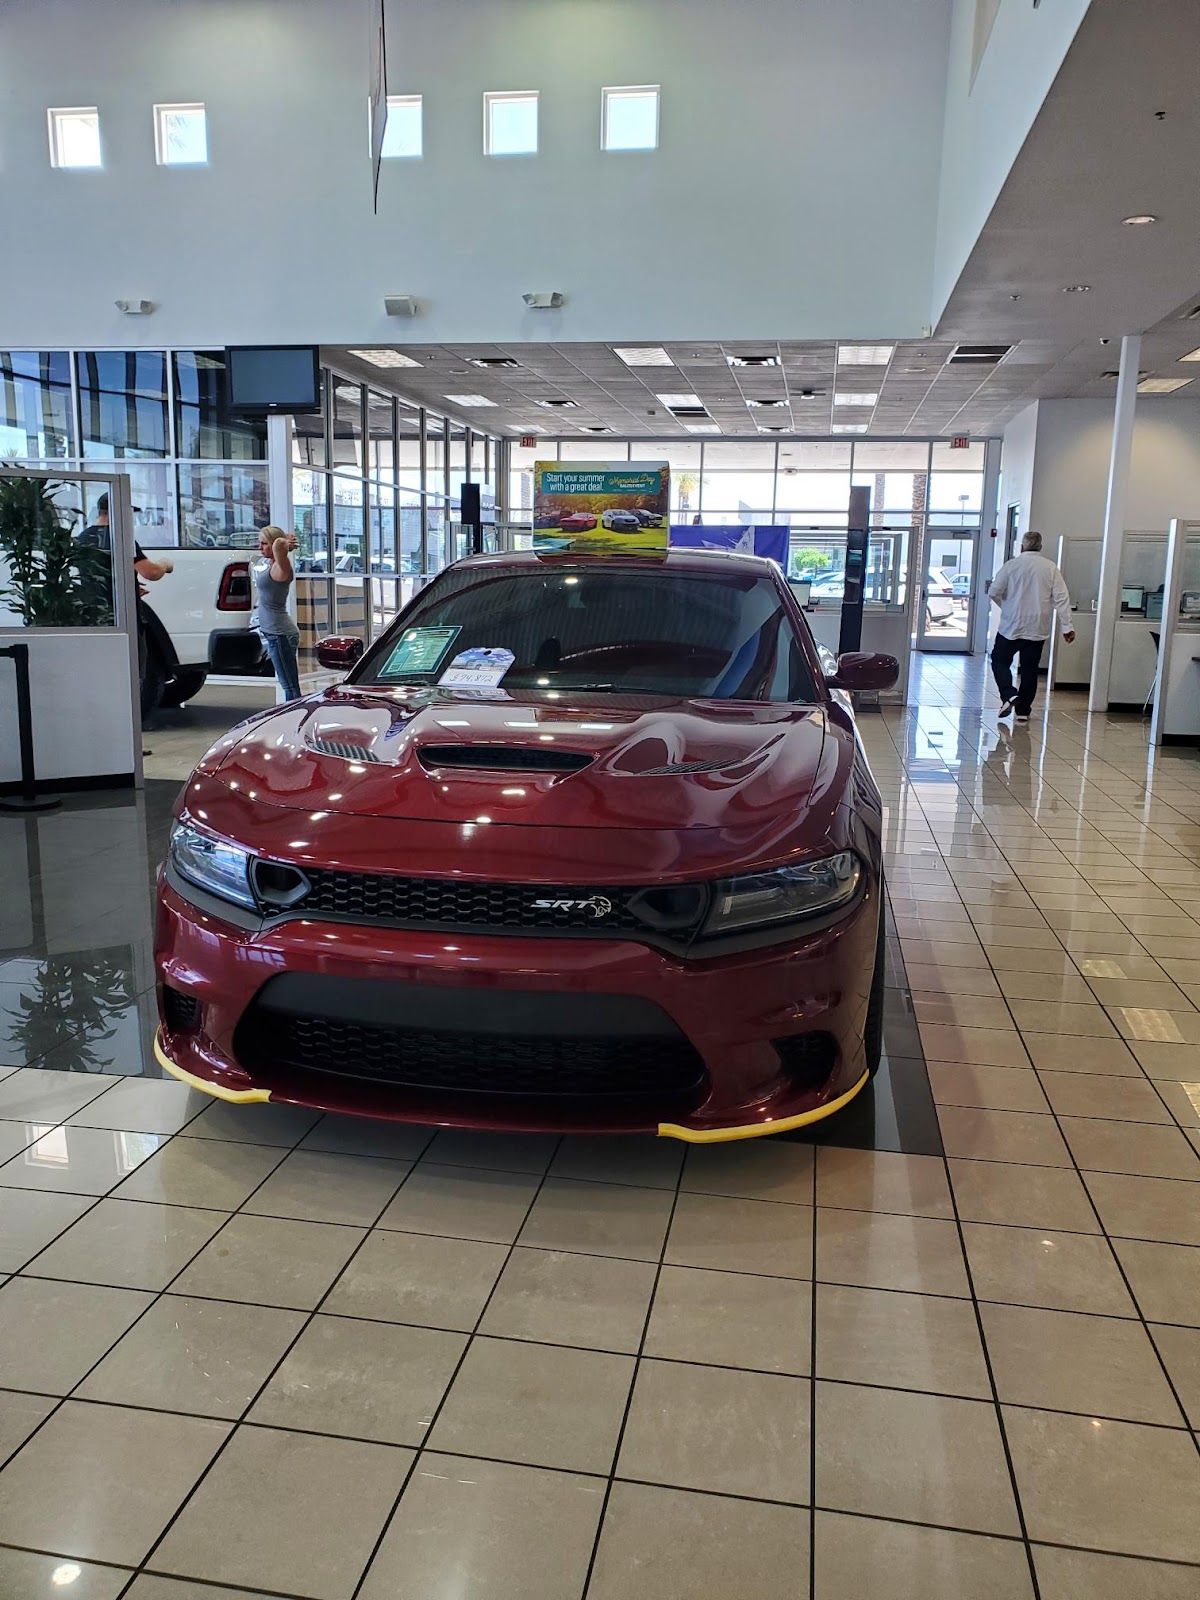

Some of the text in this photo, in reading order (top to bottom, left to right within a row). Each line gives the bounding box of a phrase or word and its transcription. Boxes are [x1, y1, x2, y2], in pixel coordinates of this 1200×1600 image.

[954, 437, 968, 448] EXIT
[546, 472, 606, 483] Start your summer
[550, 482, 564, 491] with
[569, 483, 588, 493] great
[587, 482, 604, 491] deal.
[530, 899, 595, 912] SRT
